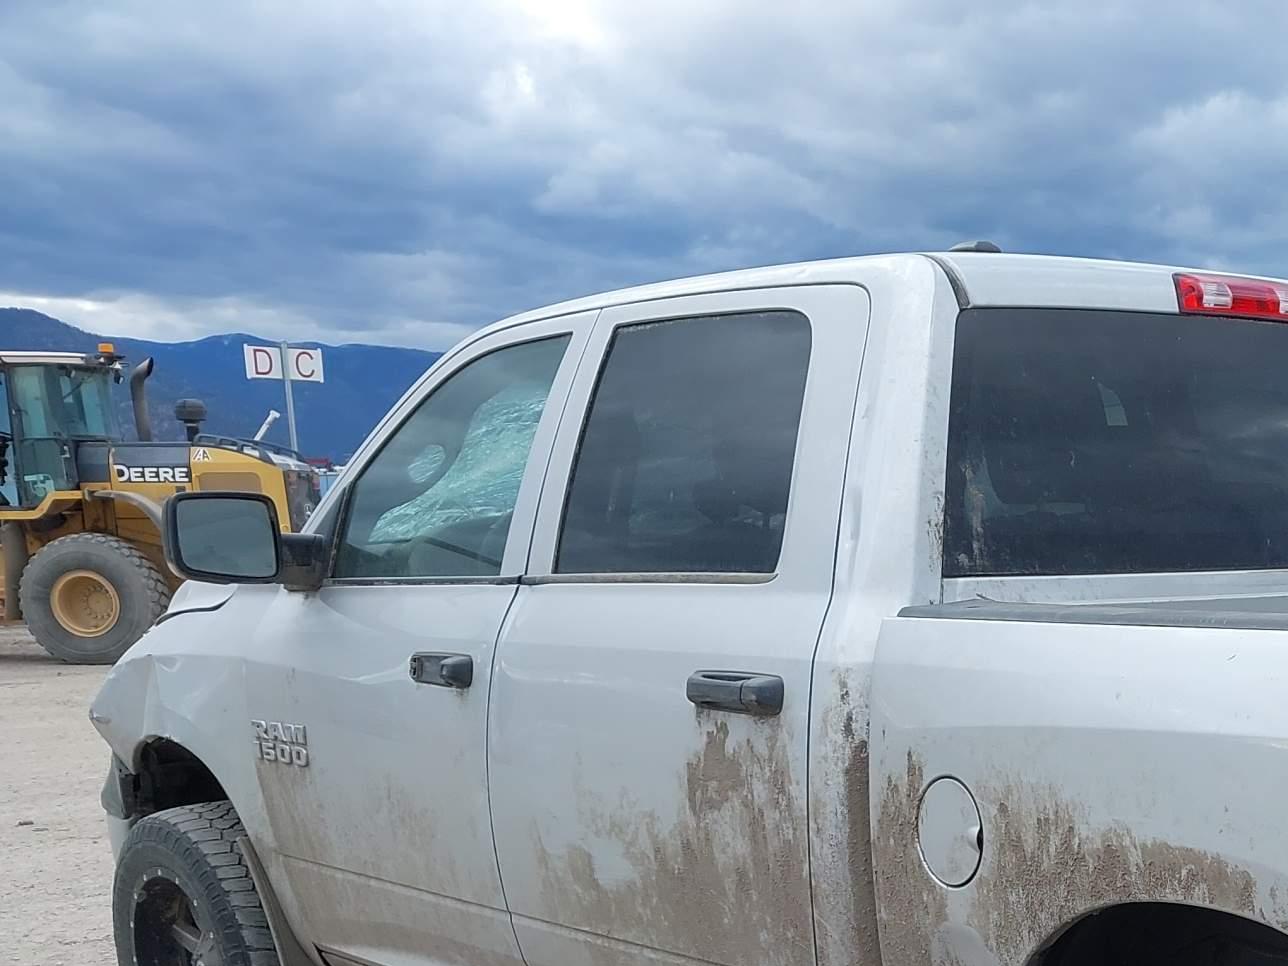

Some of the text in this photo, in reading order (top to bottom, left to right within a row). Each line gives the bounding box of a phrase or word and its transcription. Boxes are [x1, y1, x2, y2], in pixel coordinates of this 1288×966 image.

[253, 348, 315, 378] D C
[113, 464, 189, 482] DEERE
[251, 719, 307, 745] RAM
[253, 740, 310, 767] 1500
